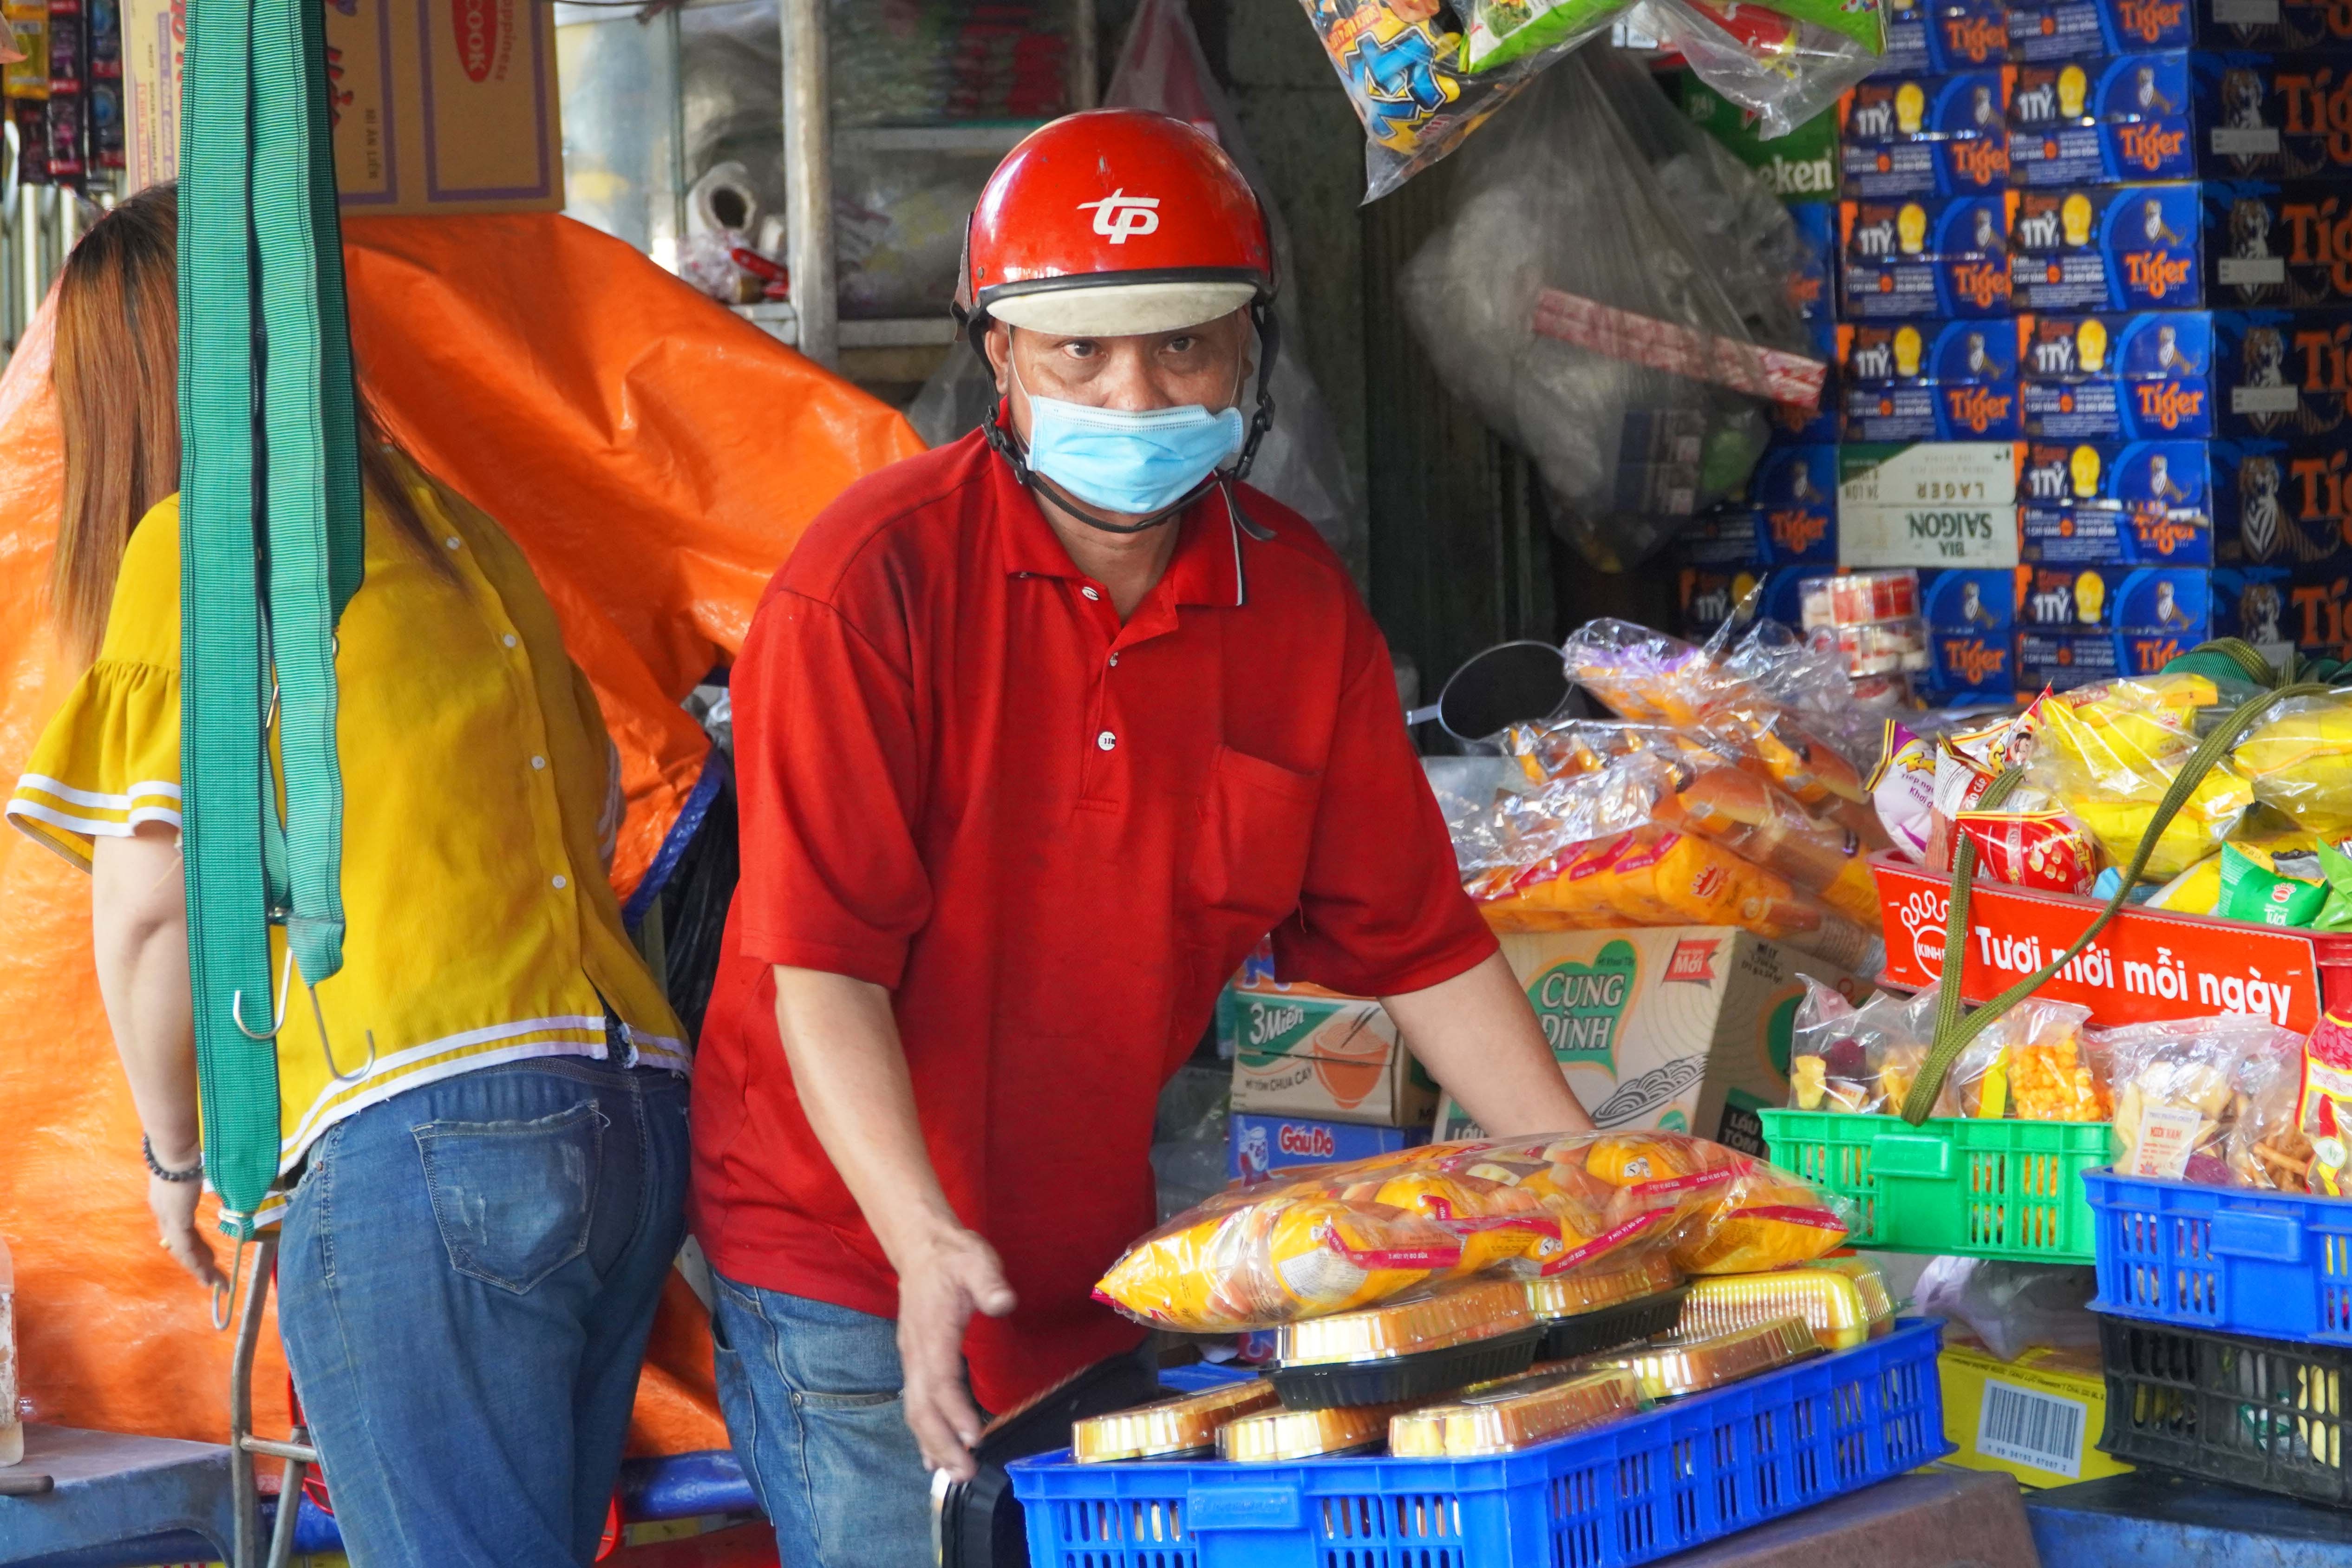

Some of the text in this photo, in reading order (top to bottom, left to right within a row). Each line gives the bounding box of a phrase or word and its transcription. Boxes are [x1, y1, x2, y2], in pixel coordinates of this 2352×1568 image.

[496, 0, 514, 80] appiness
[2119, 0, 2185, 42] Tiger
[2119, 123, 2185, 170] Tiger
[1953, 262, 2012, 308] Tiger
[2124, 250, 2191, 299] Tiger
[1947, 386, 2011, 432] Tiger
[2138, 381, 2204, 430] Tiger
[1915, 483, 1985, 499] LAGER
[1769, 510, 1827, 553] Tiger
[1908, 512, 1993, 539] SAIGON
[1939, 541, 1965, 557] BIA
[1944, 639, 2006, 685] Tiger
[1673, 954, 1703, 973] Mới
[1917, 943, 1941, 961] KINH
[1541, 972, 1625, 1007] CUNG
[1975, 926, 2291, 1026] Tươi mới mỗi ngày
[1541, 1009, 1614, 1050] ĐÌNH
